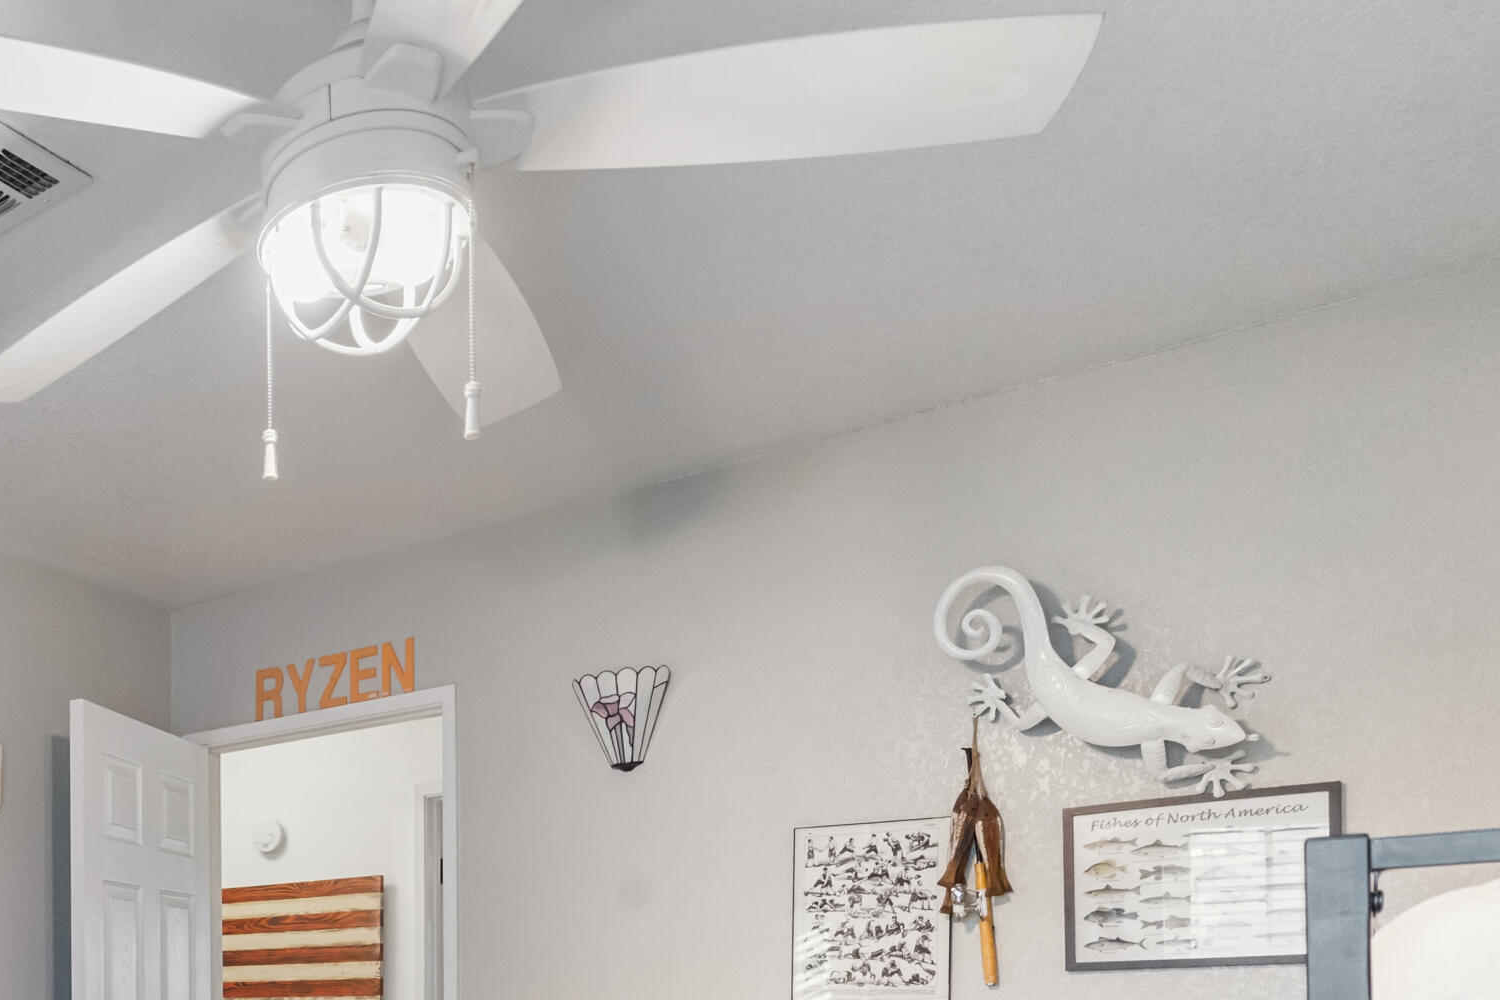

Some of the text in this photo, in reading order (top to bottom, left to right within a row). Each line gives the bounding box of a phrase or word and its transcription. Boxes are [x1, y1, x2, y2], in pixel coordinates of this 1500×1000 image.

[255, 636, 415, 722] RYZEN
[1090, 802, 1309, 833] Fishes of North America
